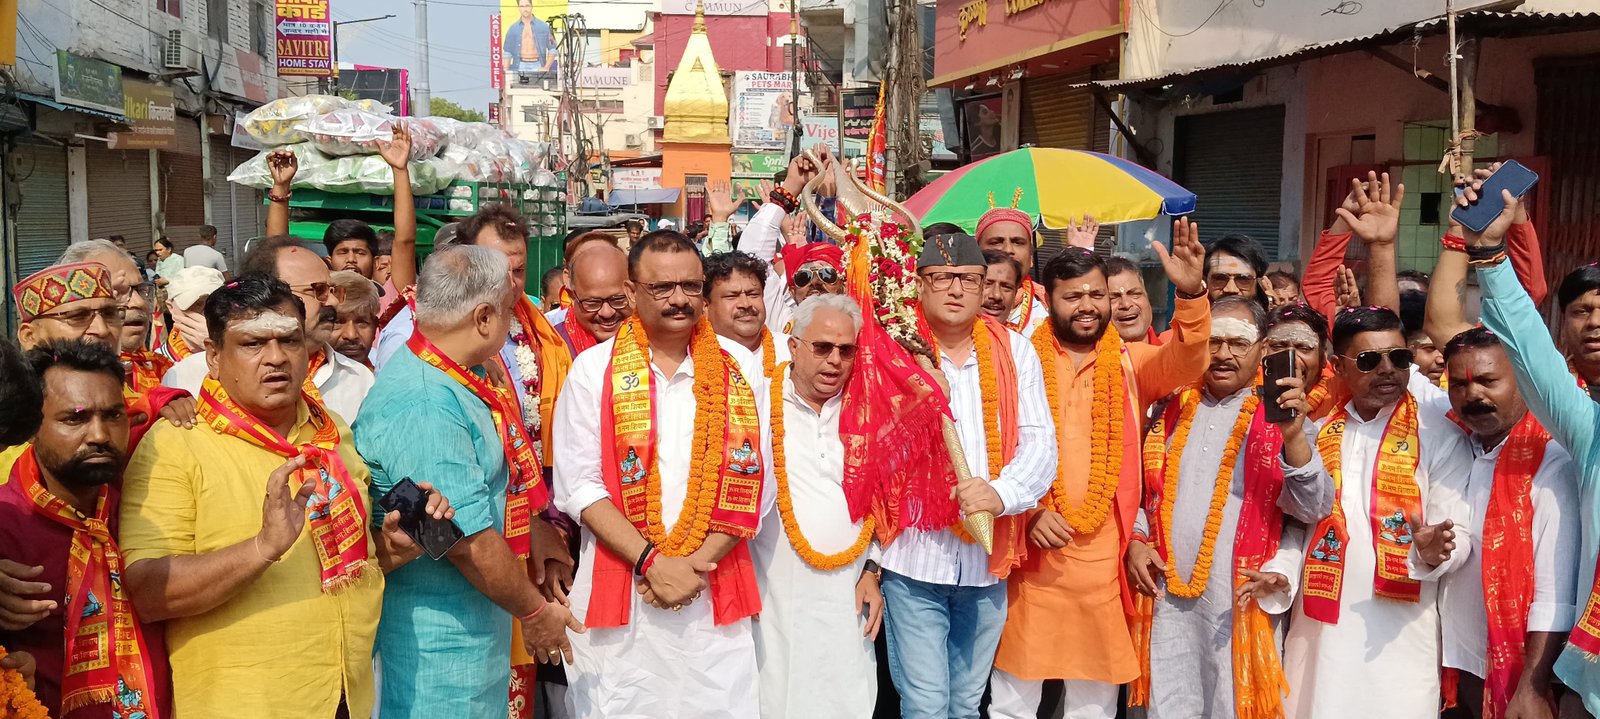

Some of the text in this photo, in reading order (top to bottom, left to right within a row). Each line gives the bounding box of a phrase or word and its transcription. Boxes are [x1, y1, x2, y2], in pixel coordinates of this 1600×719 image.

[685, 2, 742, 12] CMMUN
[278, 38, 329, 56] SAVITRI
[280, 59, 329, 68] HOME STAY
[582, 76, 628, 86] MMUNE
[805, 124, 836, 140] Vije
[620, 372, 640, 390] ॐ
